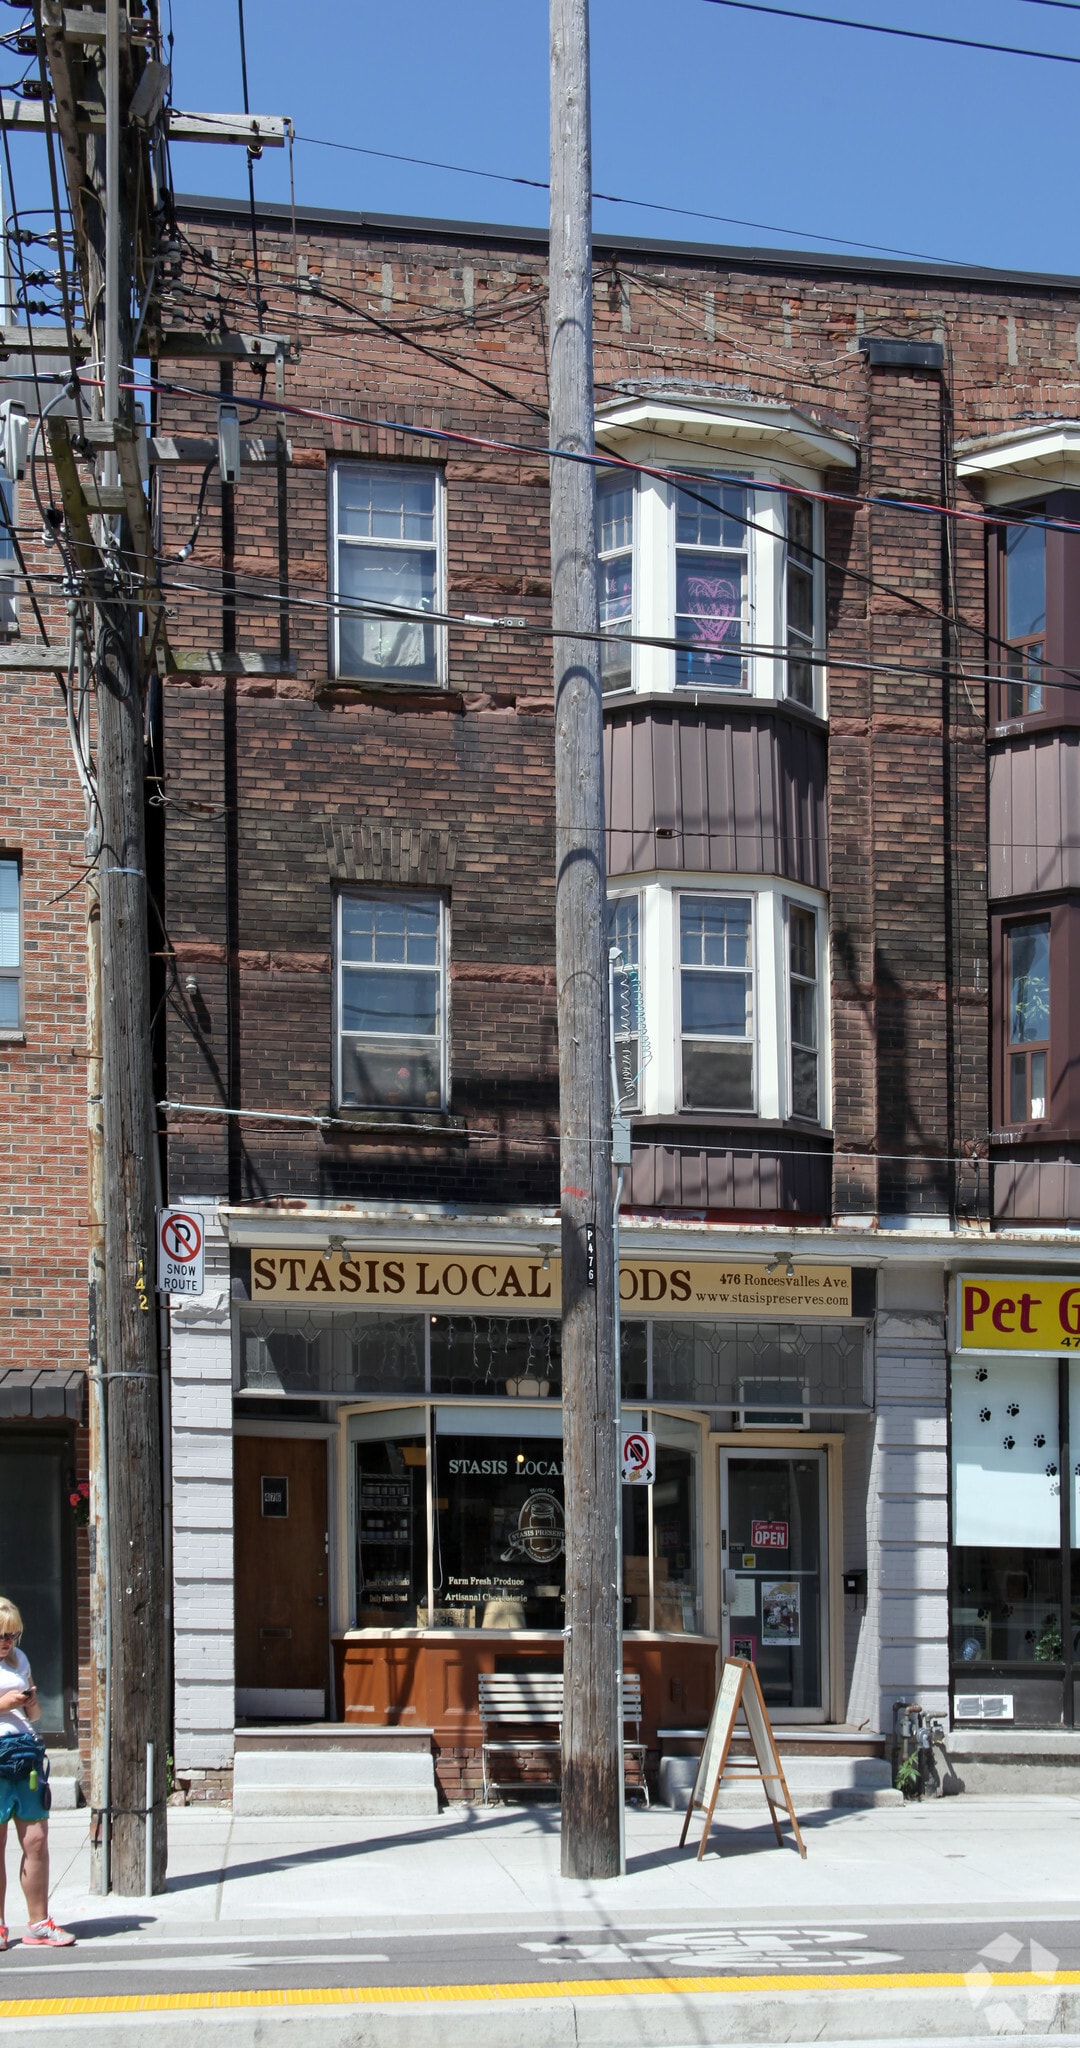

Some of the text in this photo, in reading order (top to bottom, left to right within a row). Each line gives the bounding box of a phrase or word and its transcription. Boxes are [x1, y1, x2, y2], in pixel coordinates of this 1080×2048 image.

[166, 1263, 196, 1277] SNOW
[164, 1278, 198, 1291] ROUTE
[253, 1257, 693, 1302] STASIS LOCAL ODS
[719, 1273, 849, 1288] 476 Roncesvalles Ave.
[695, 1291, 849, 1307] www.stasispreserves.com
[964, 1286, 1042, 1334] Pet
[448, 1459, 508, 1475] STASIS
[512, 1529, 566, 1541] STASIS PRESERV
[754, 1530, 785, 1546] OPEN
[448, 1576, 525, 1586] Farm Fresh Produce
[445, 1592, 481, 1602] Artisanal
[441, 1616, 454, 1627] 36
